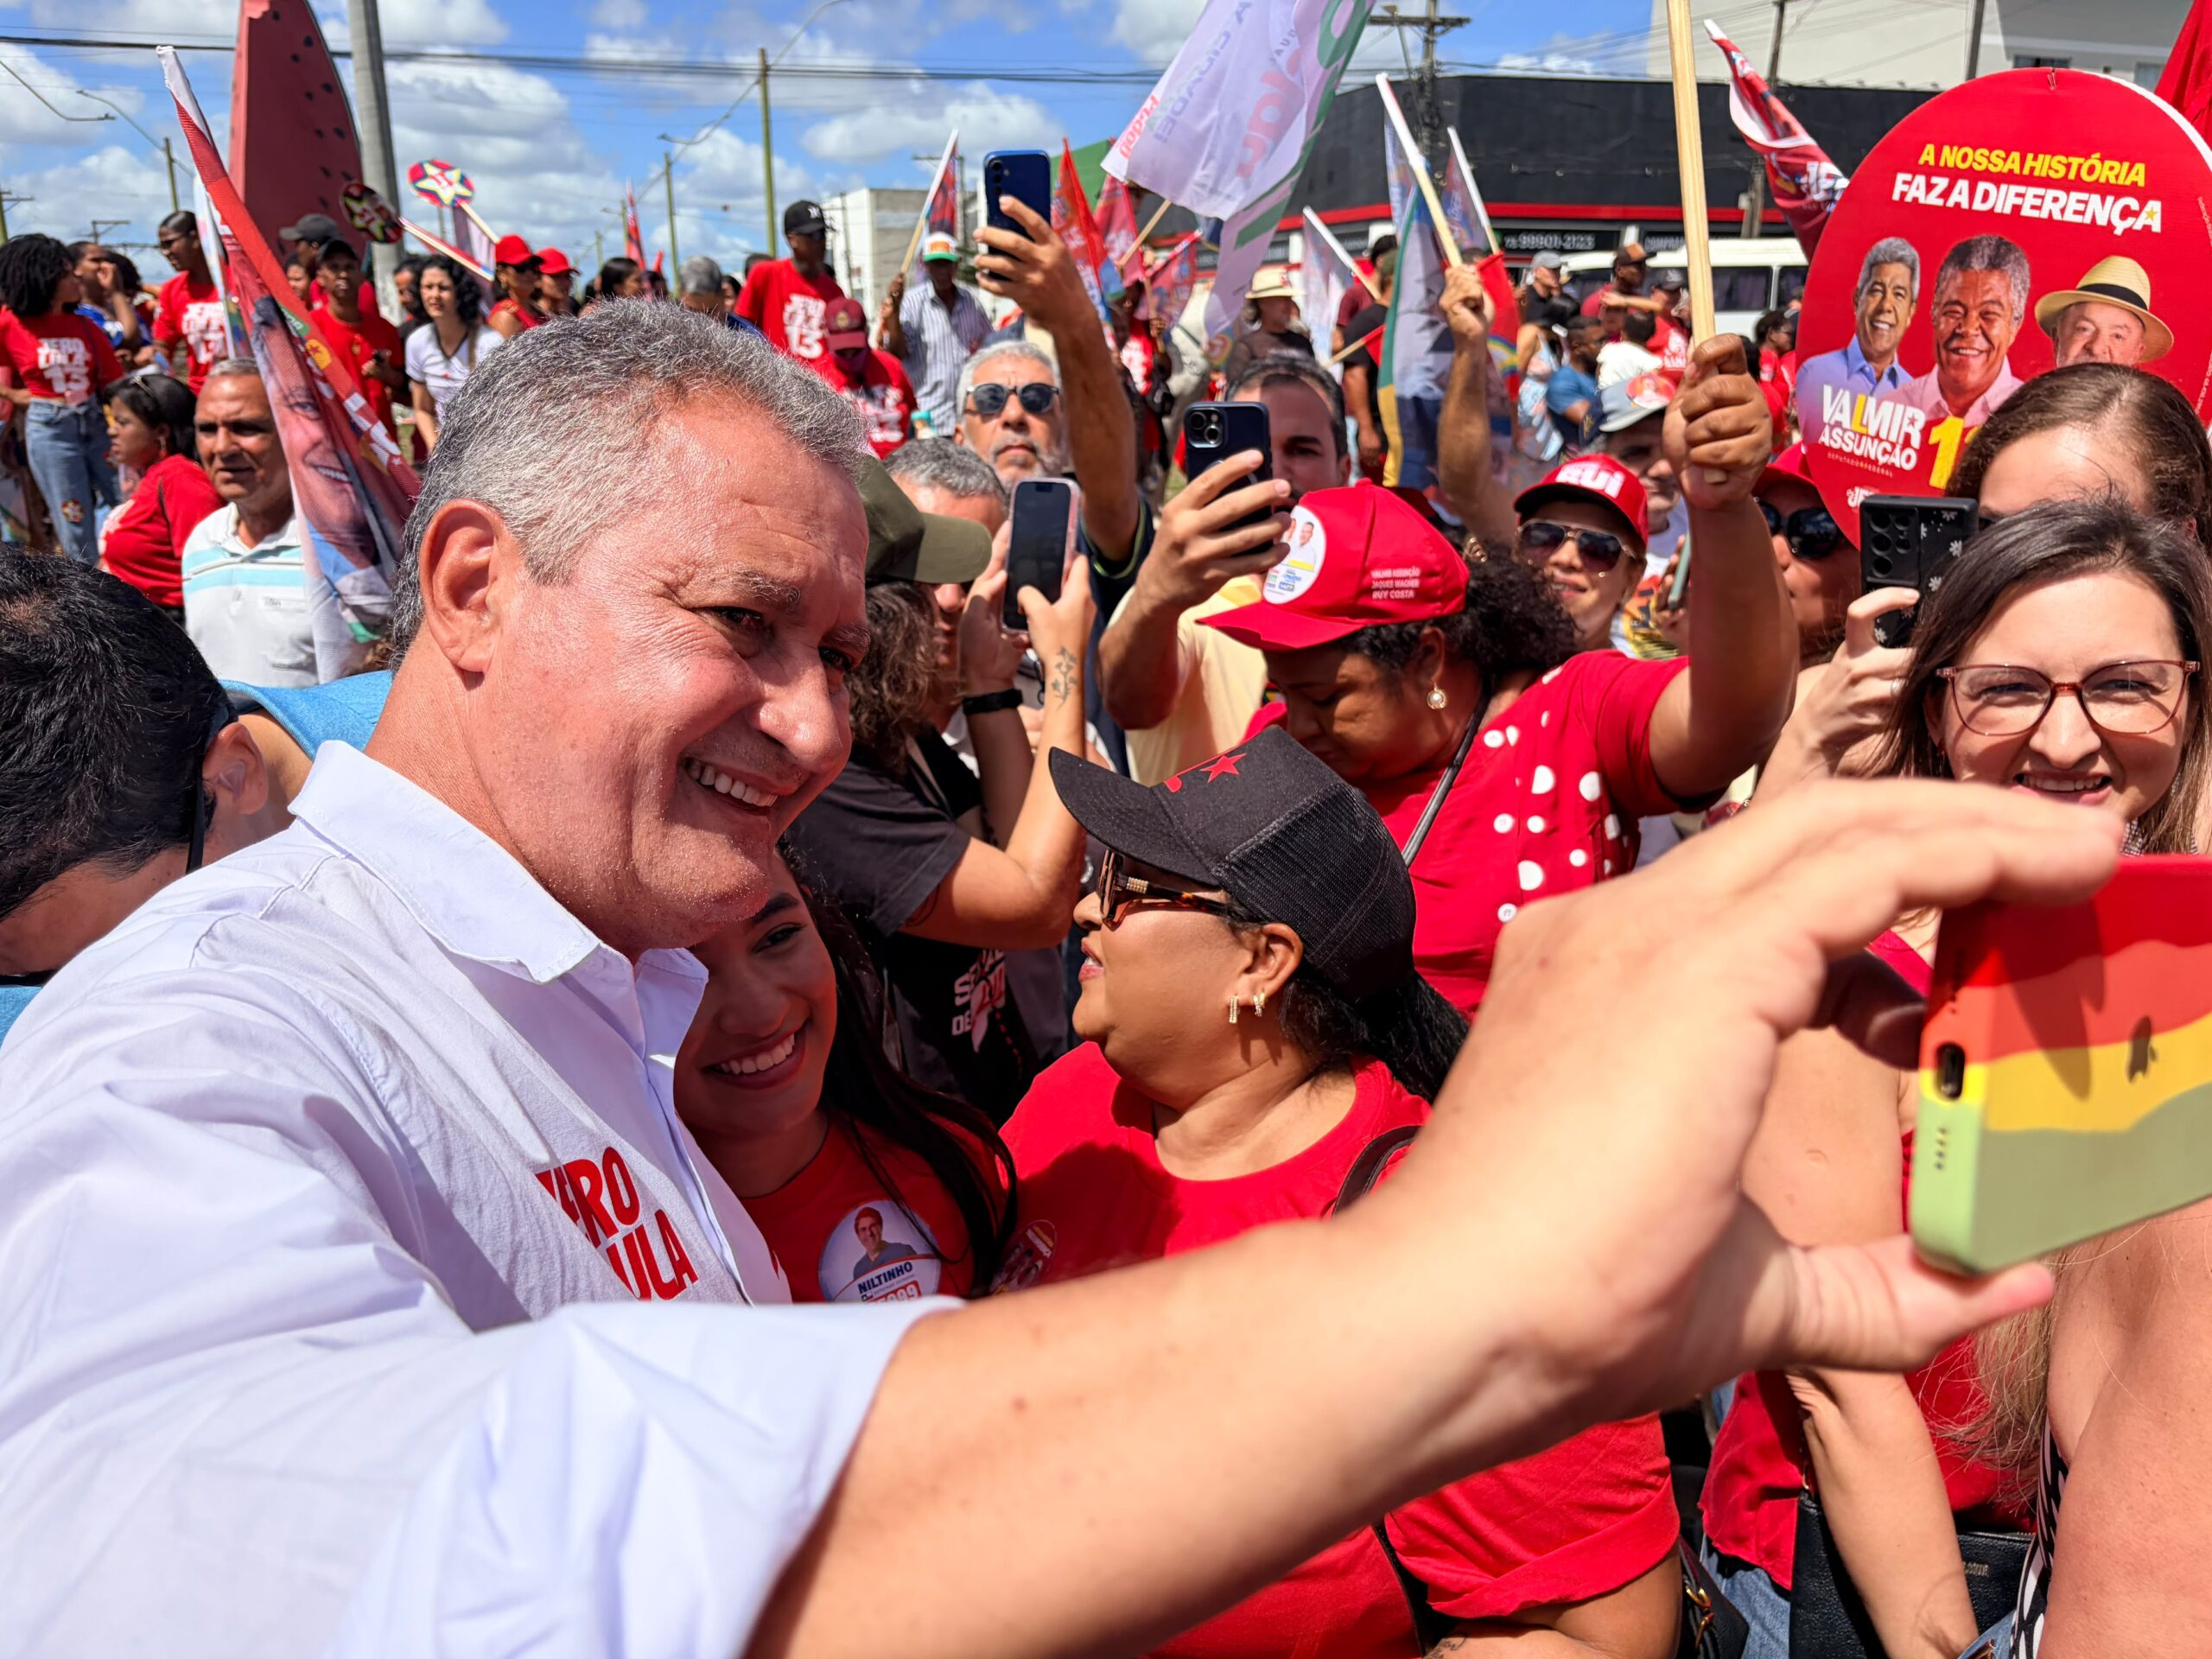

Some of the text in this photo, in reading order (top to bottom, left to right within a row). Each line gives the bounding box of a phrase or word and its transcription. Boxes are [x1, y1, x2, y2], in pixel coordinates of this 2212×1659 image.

[1918, 143, 2145, 187] A NOSSA HISTÓRIA
[1891, 172, 1949, 207] FAZ
[1945, 179, 1970, 209] A
[1972, 181, 2162, 236] DIFERENÇA
[1823, 385, 1925, 449] VALMIR
[1818, 424, 1917, 470] ASSUNÇÃO
[1389, 589, 1414, 599] COSTA
[857, 1262, 913, 1294] NILTINHO
